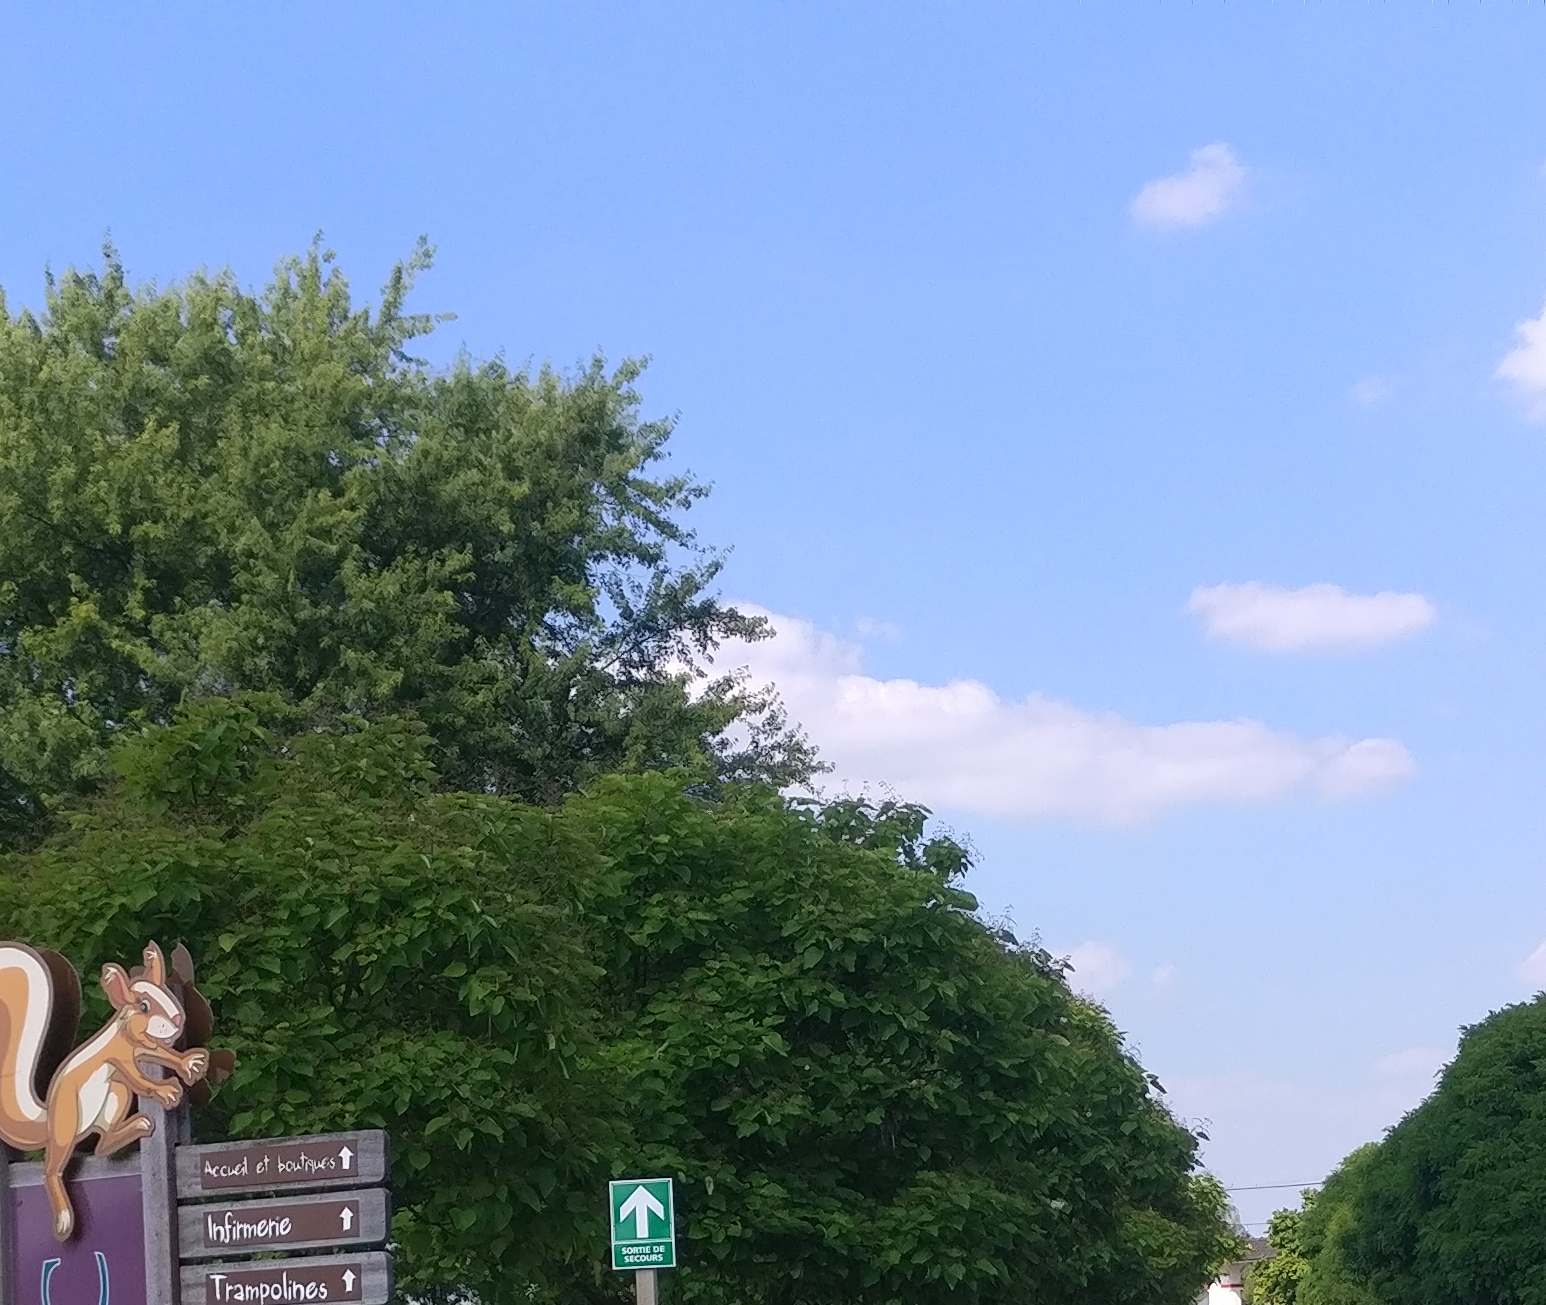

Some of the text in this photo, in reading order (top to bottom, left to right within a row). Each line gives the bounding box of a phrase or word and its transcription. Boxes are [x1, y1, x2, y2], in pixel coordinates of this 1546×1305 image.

[204, 1151, 336, 1178] Accueil et boutiques
[207, 1211, 292, 1244] Infirmerie
[621, 1245, 665, 1255] SORTIE DE
[624, 1254, 663, 1263] SECOURS
[210, 1270, 328, 1305] Trampolines
